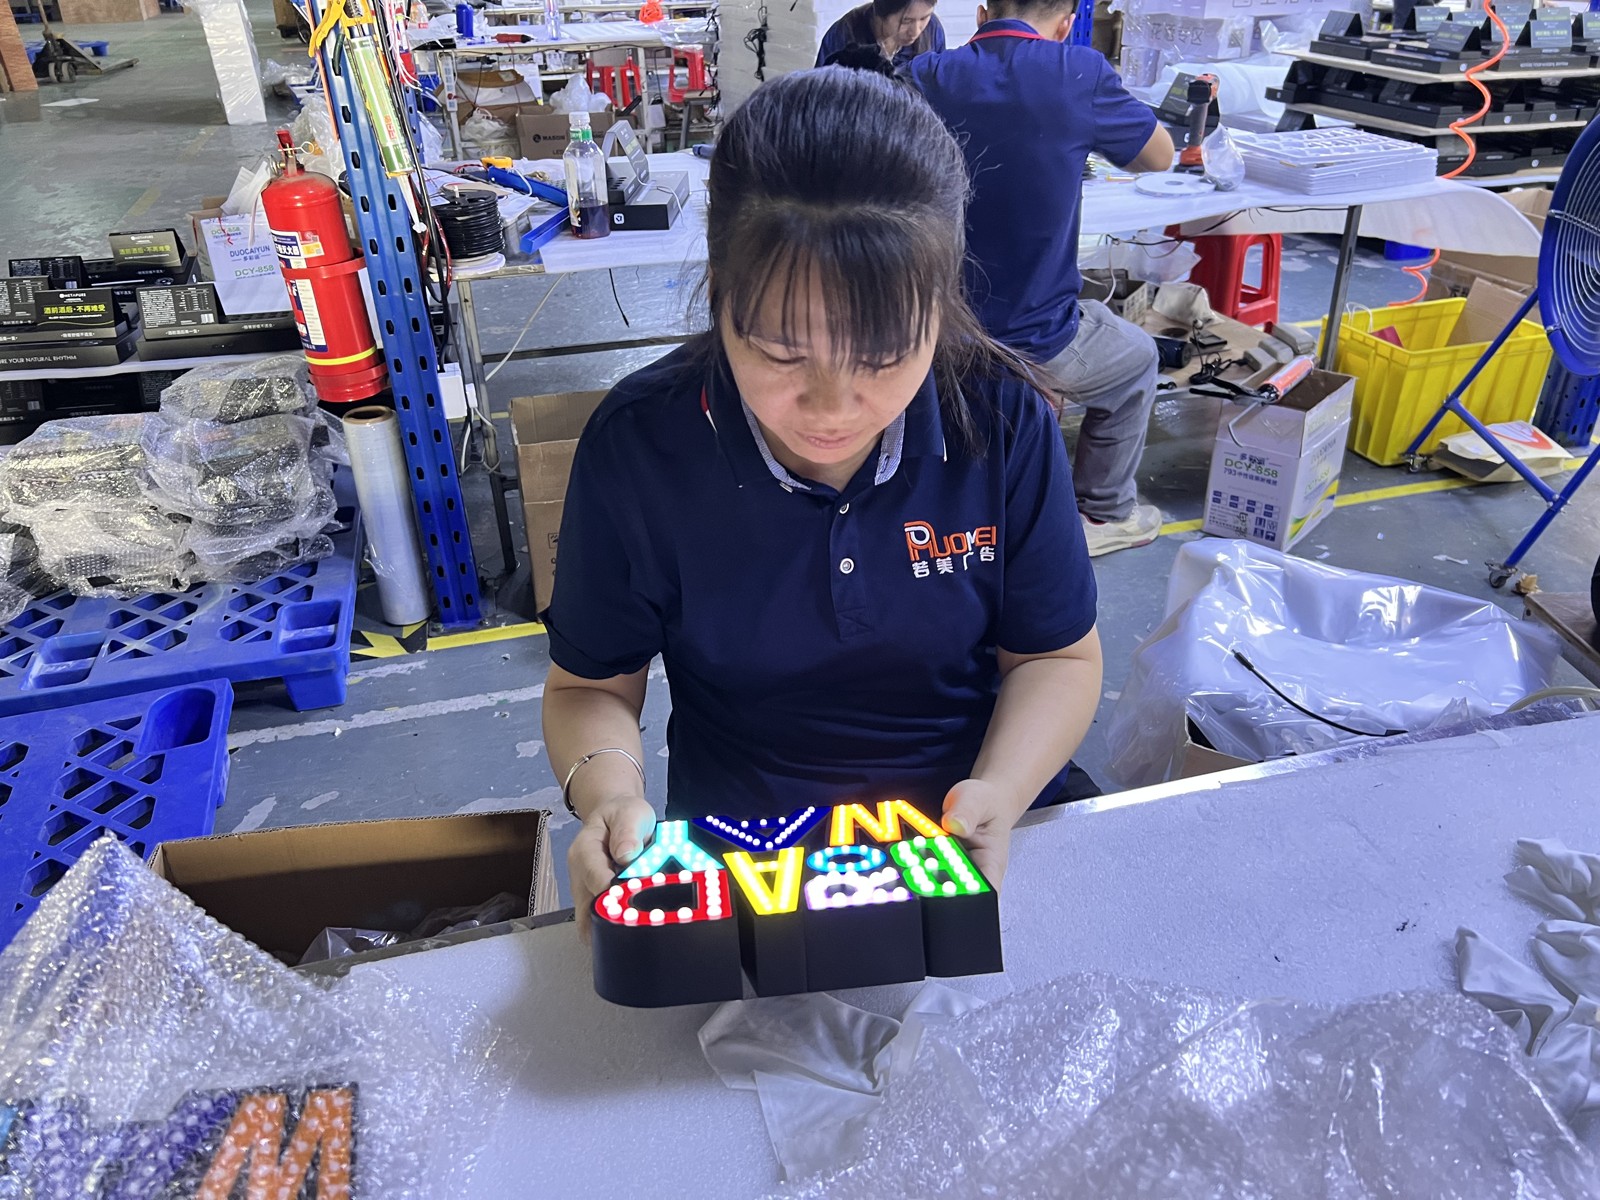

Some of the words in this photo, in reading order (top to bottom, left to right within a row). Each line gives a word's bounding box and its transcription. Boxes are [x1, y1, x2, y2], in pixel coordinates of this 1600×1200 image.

[229, 245, 271, 257] DUOCAIYUN
[235, 264, 274, 276] DCY-858
[26, 354, 51, 362] NATURAL
[1224, 458, 1278, 478] DCY-858
